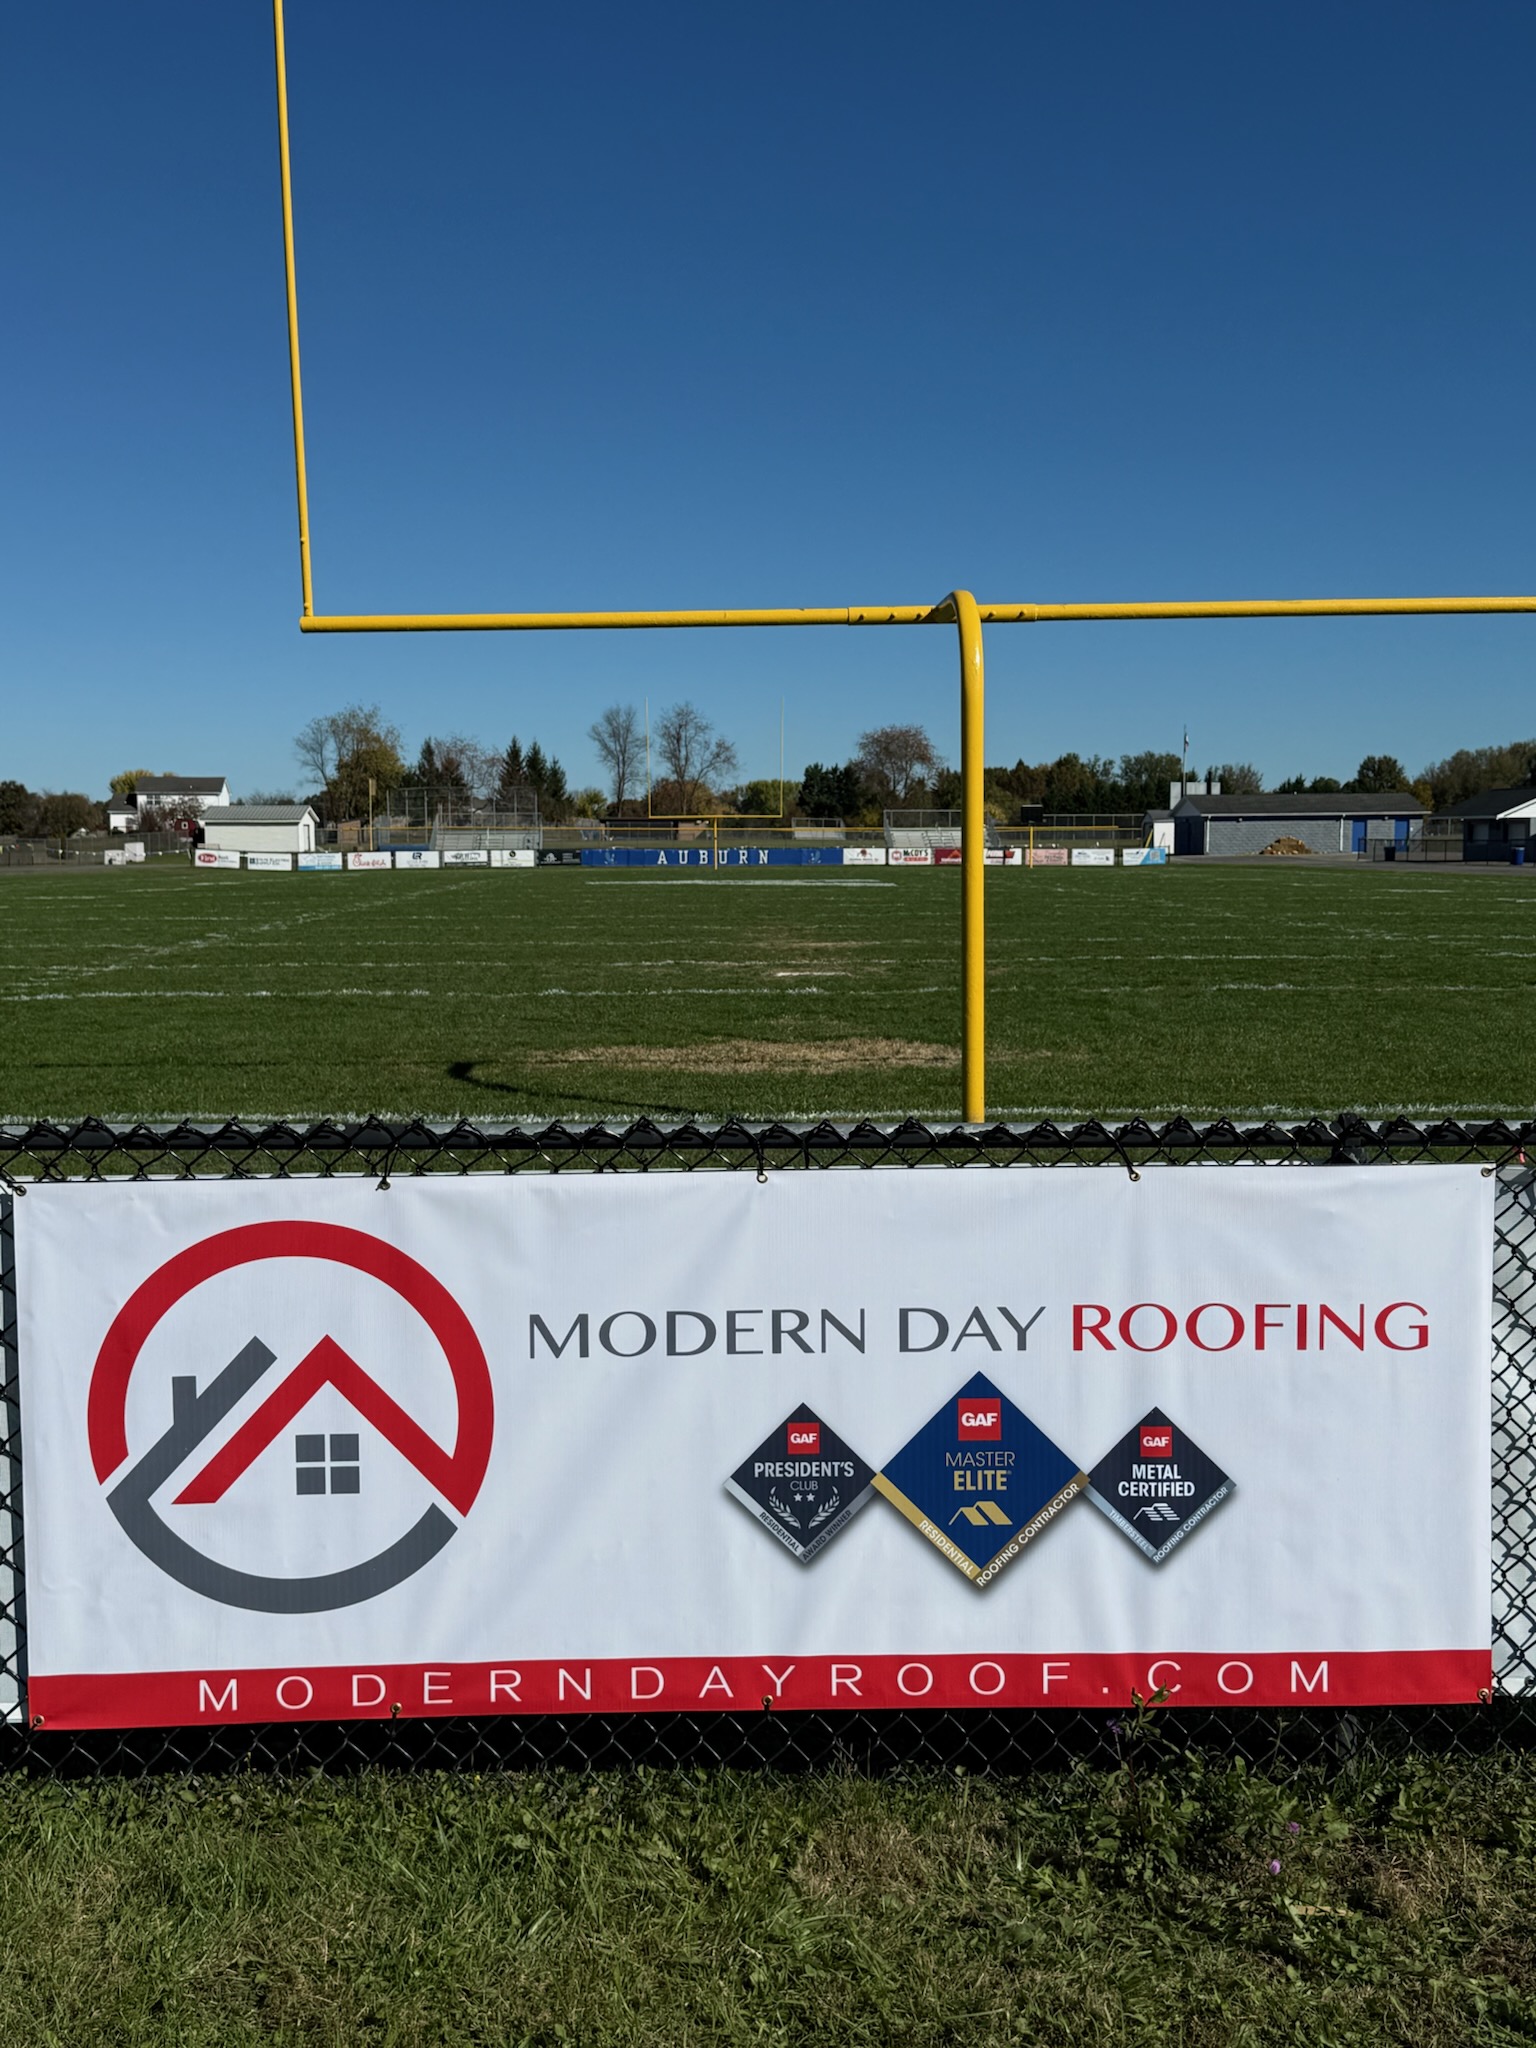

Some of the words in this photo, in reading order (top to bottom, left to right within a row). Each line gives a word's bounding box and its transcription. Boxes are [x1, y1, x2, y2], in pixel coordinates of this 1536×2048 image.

[657, 850, 769, 865] AUBURN
[528, 1308, 866, 1359] MODERN
[898, 1306, 1047, 1353] DAY
[1072, 1302, 1430, 1352] ROOFING
[961, 1413, 998, 1427] GAF
[790, 1432, 818, 1444] GAF
[1142, 1436, 1170, 1447] GAF
[945, 1451, 1016, 1467] MASTER
[754, 1461, 855, 1478] PRESIDENT'S
[1132, 1464, 1182, 1480] METAL
[789, 1480, 819, 1491] CLUB
[1117, 1481, 1196, 1497] CERTIFIED
[759, 1511, 800, 1553] RESIDENTIAL
[1153, 1531, 1185, 1563] ROOFING
[1183, 1486, 1229, 1532] CONTRACTOR
[802, 1536, 827, 1561] AWARD
[827, 1509, 853, 1538] WINNER
[976, 1543, 1020, 1587] ROOFING
[1018, 1482, 1081, 1545] CONTRACTOR
[918, 1519, 974, 1576] RESIDENTIAL
[198, 1658, 1331, 1713] MODERNDAYROOF.COM
